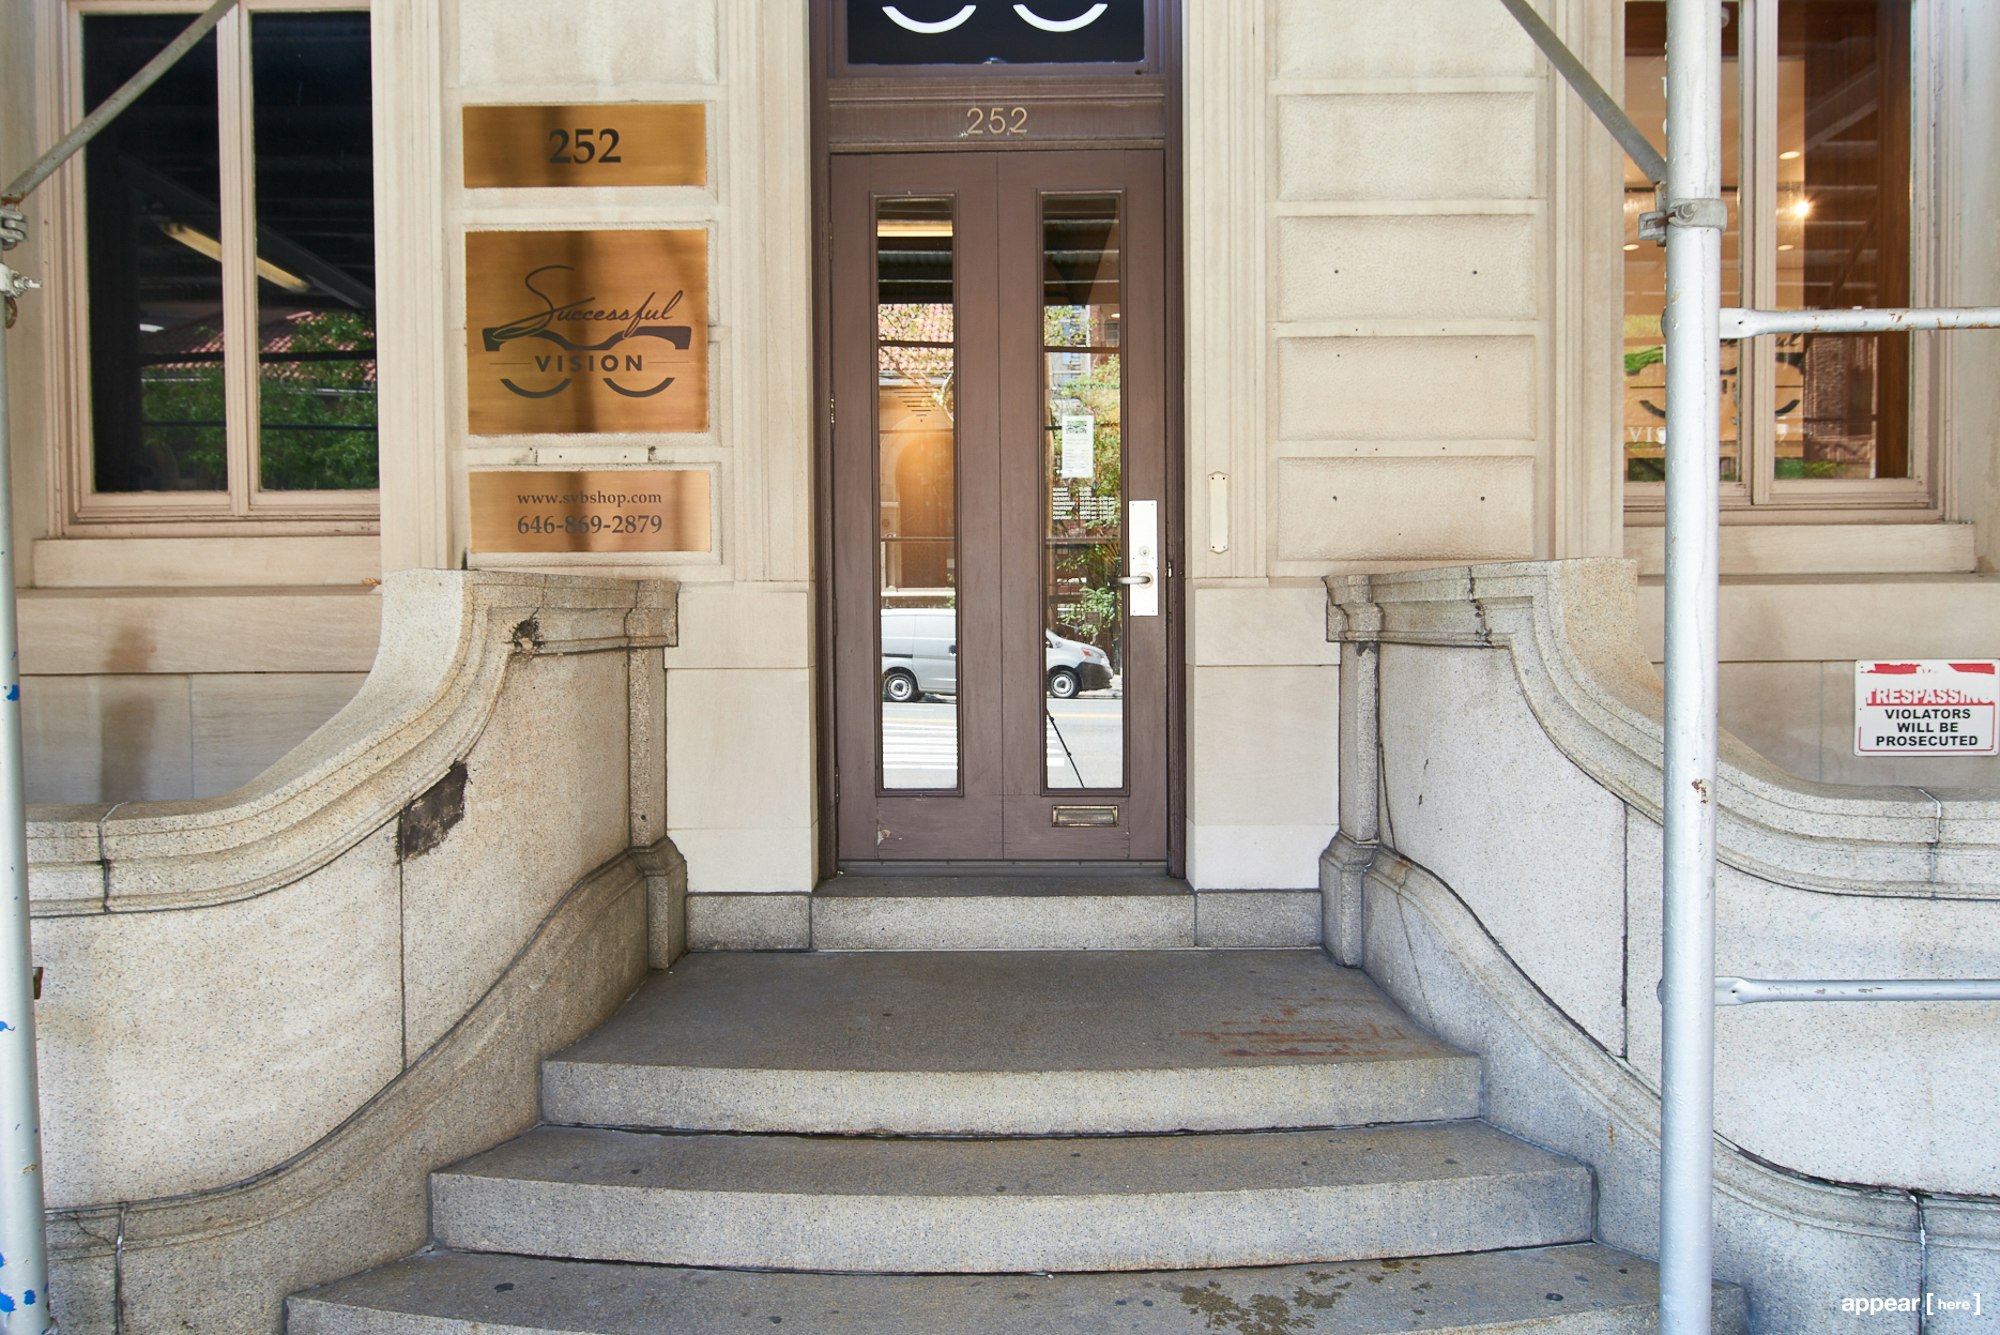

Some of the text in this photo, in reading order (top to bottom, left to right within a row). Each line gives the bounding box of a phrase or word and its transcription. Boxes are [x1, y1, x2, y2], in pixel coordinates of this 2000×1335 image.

[966, 106, 1028, 135] 252
[548, 127, 622, 164] 252
[492, 264, 684, 341] Successful
[534, 353, 644, 373] VISION
[516, 490, 662, 508] www.svbshop.com
[516, 514, 663, 535] 646-869-2879
[1884, 708, 1971, 720] VIOLATORS
[1896, 722, 1959, 733] WILL BE
[1875, 735, 1979, 747] PROSECUTED
